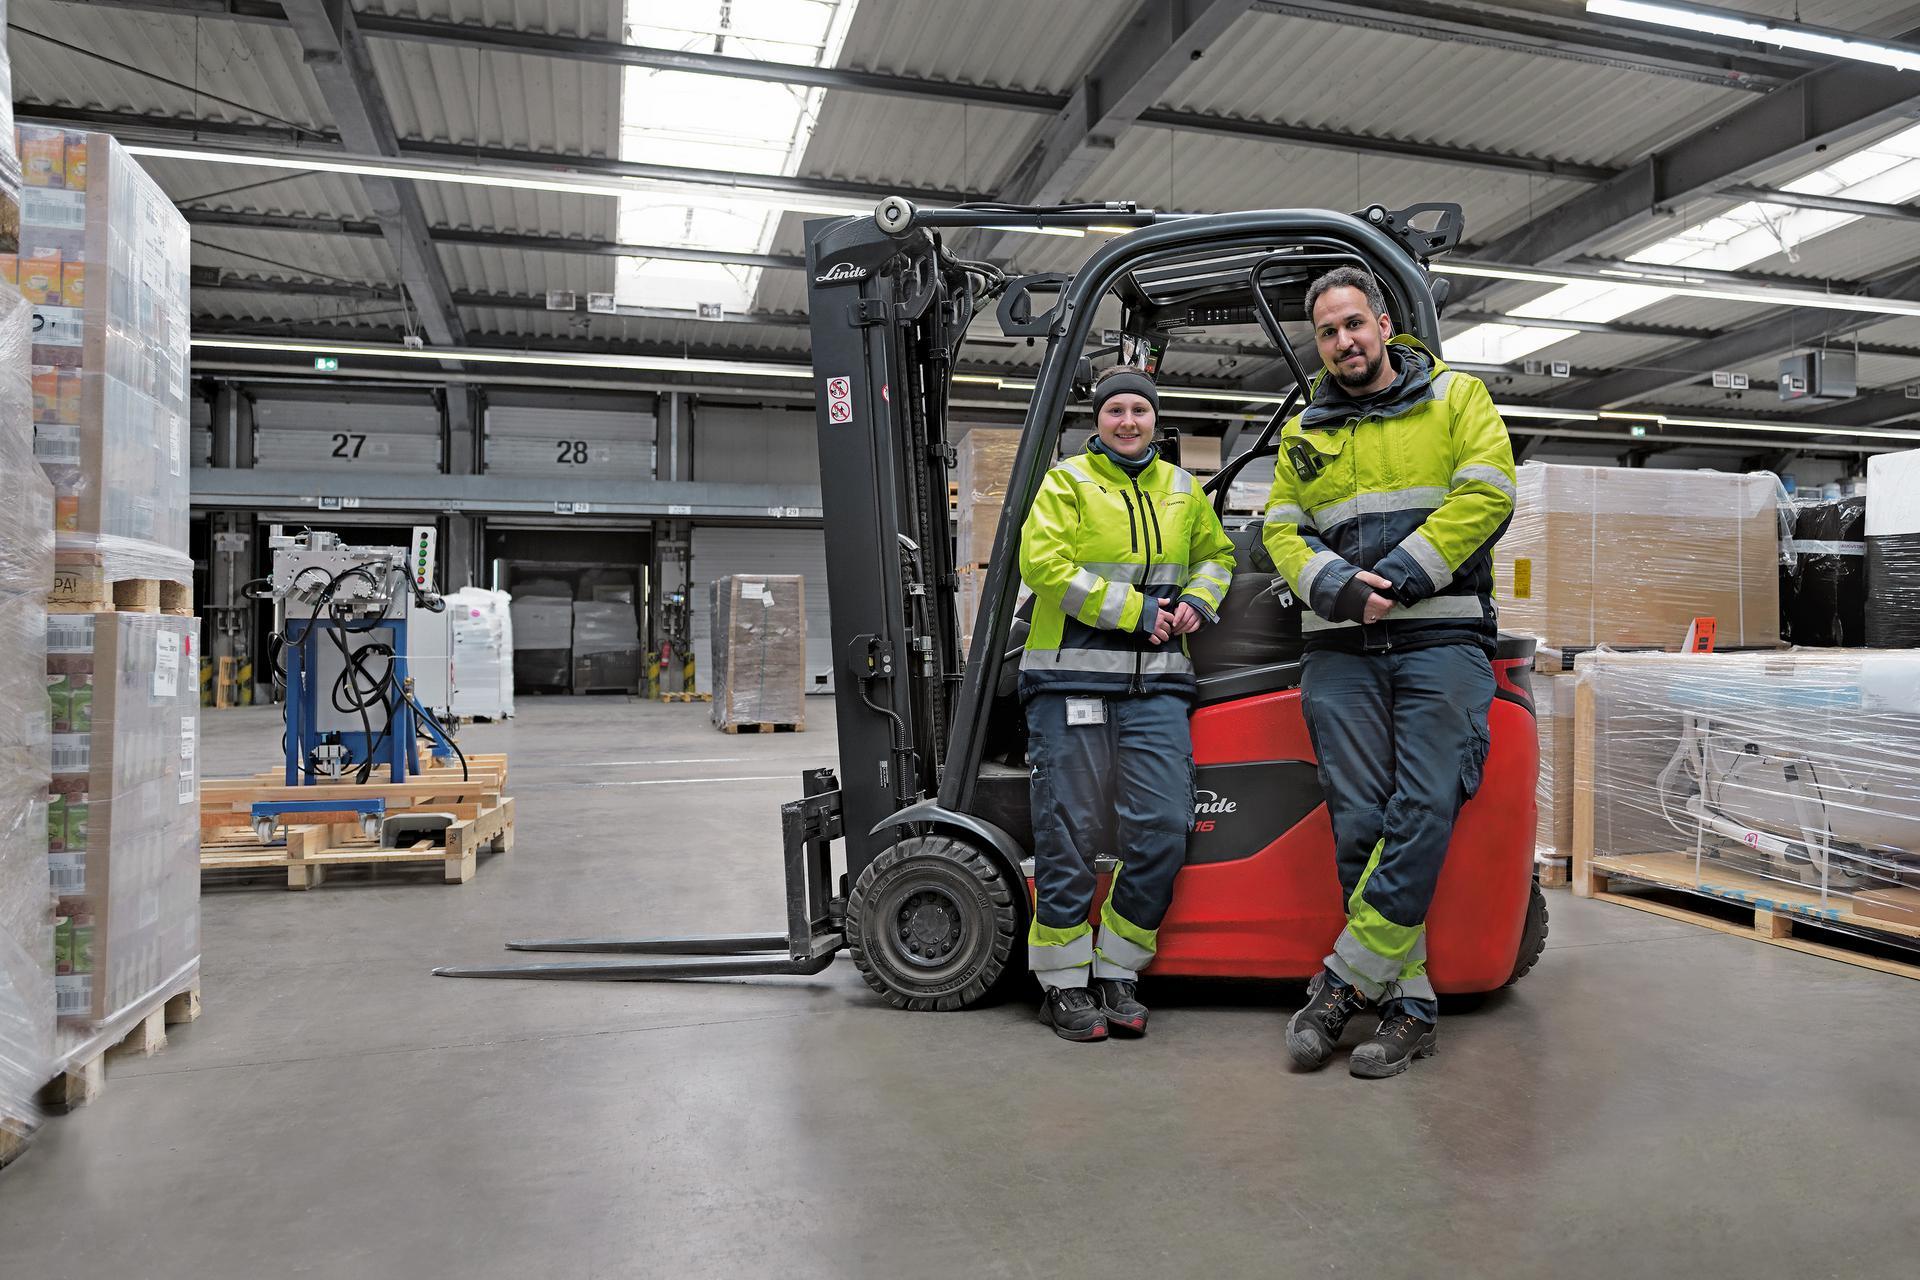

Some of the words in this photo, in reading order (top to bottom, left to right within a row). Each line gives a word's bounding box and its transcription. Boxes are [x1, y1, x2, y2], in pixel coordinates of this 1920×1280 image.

[816, 262, 868, 283] Linde
[331, 433, 367, 459] 27
[556, 440, 589, 465] 28
[1194, 790, 1237, 814] nde
